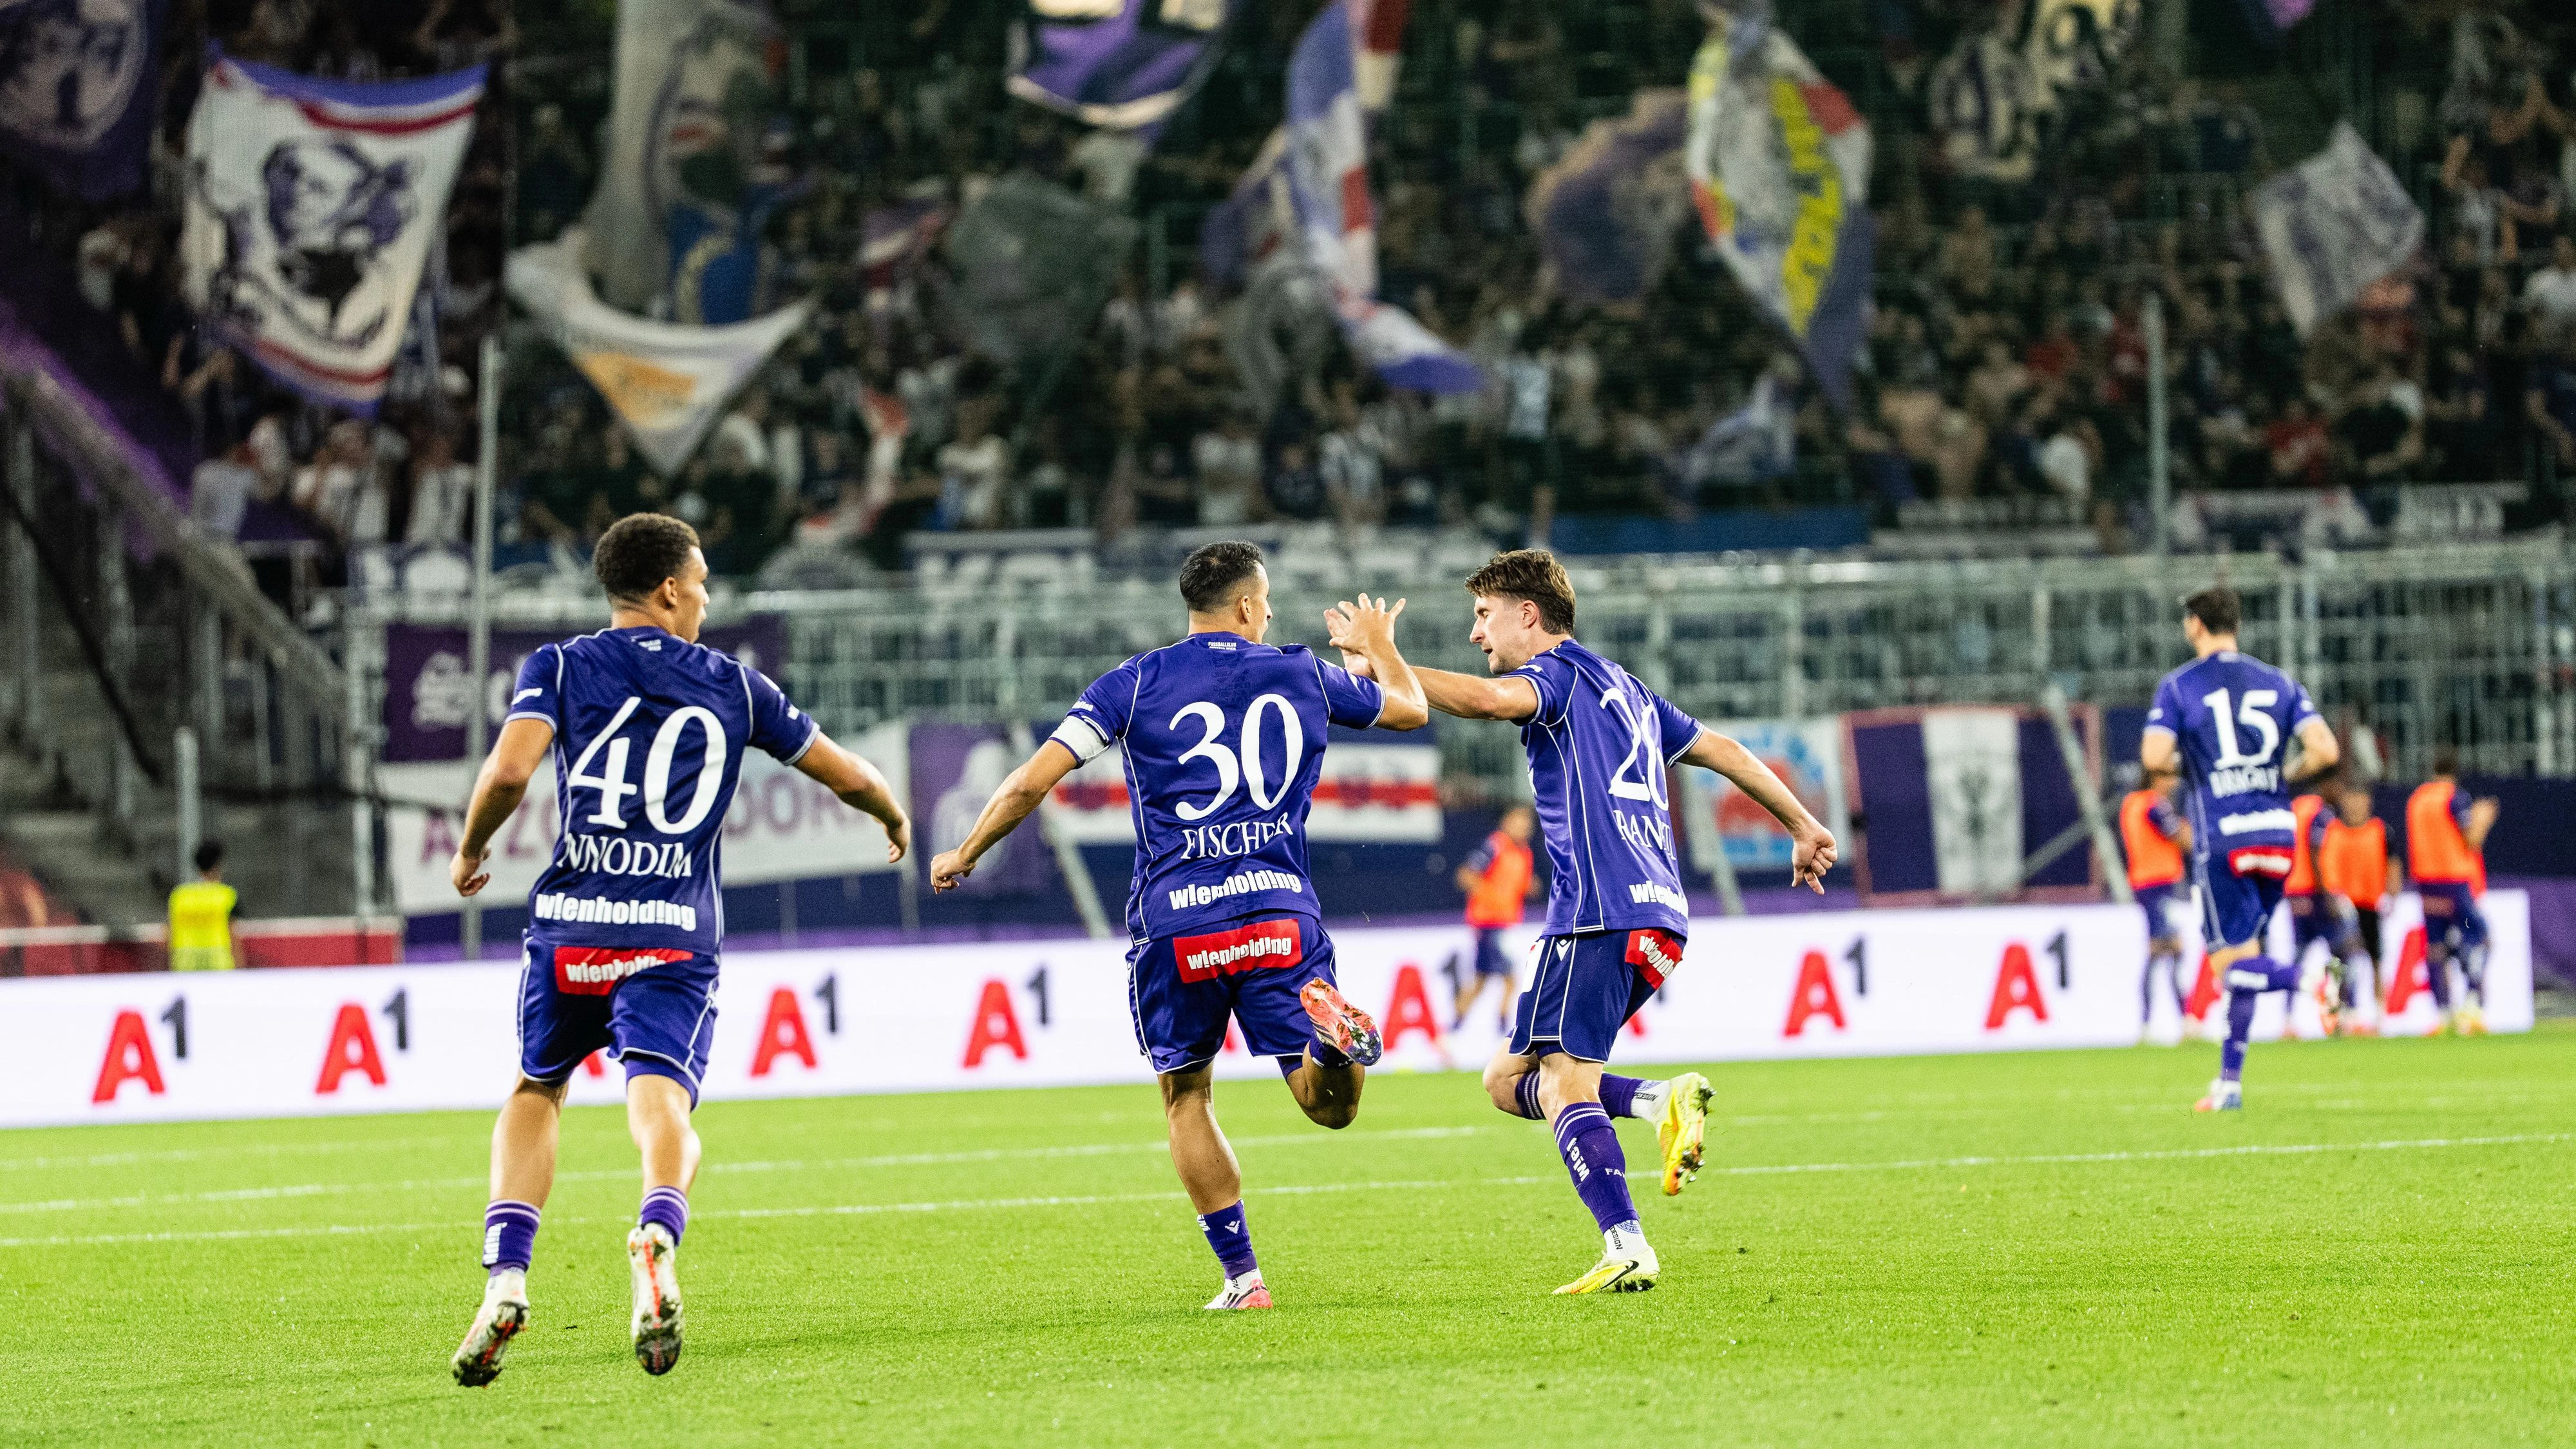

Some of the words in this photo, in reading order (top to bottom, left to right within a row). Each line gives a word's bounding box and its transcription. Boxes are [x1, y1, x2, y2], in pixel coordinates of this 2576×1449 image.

[568, 696, 726, 834] 40
[1169, 693, 1303, 820] 30
[1600, 688, 1669, 811] 26
[2203, 687, 2280, 770] 15
[556, 832, 692, 879] NNODIM
[1180, 811, 1293, 860] FISCHER
[750, 972, 839, 1078] A1
[963, 967, 1048, 1069] A1
[1783, 935, 1867, 1039] A1
[1985, 929, 2069, 1030] A1
[92, 993, 187, 1105] A1
[315, 986, 409, 1096] A1
